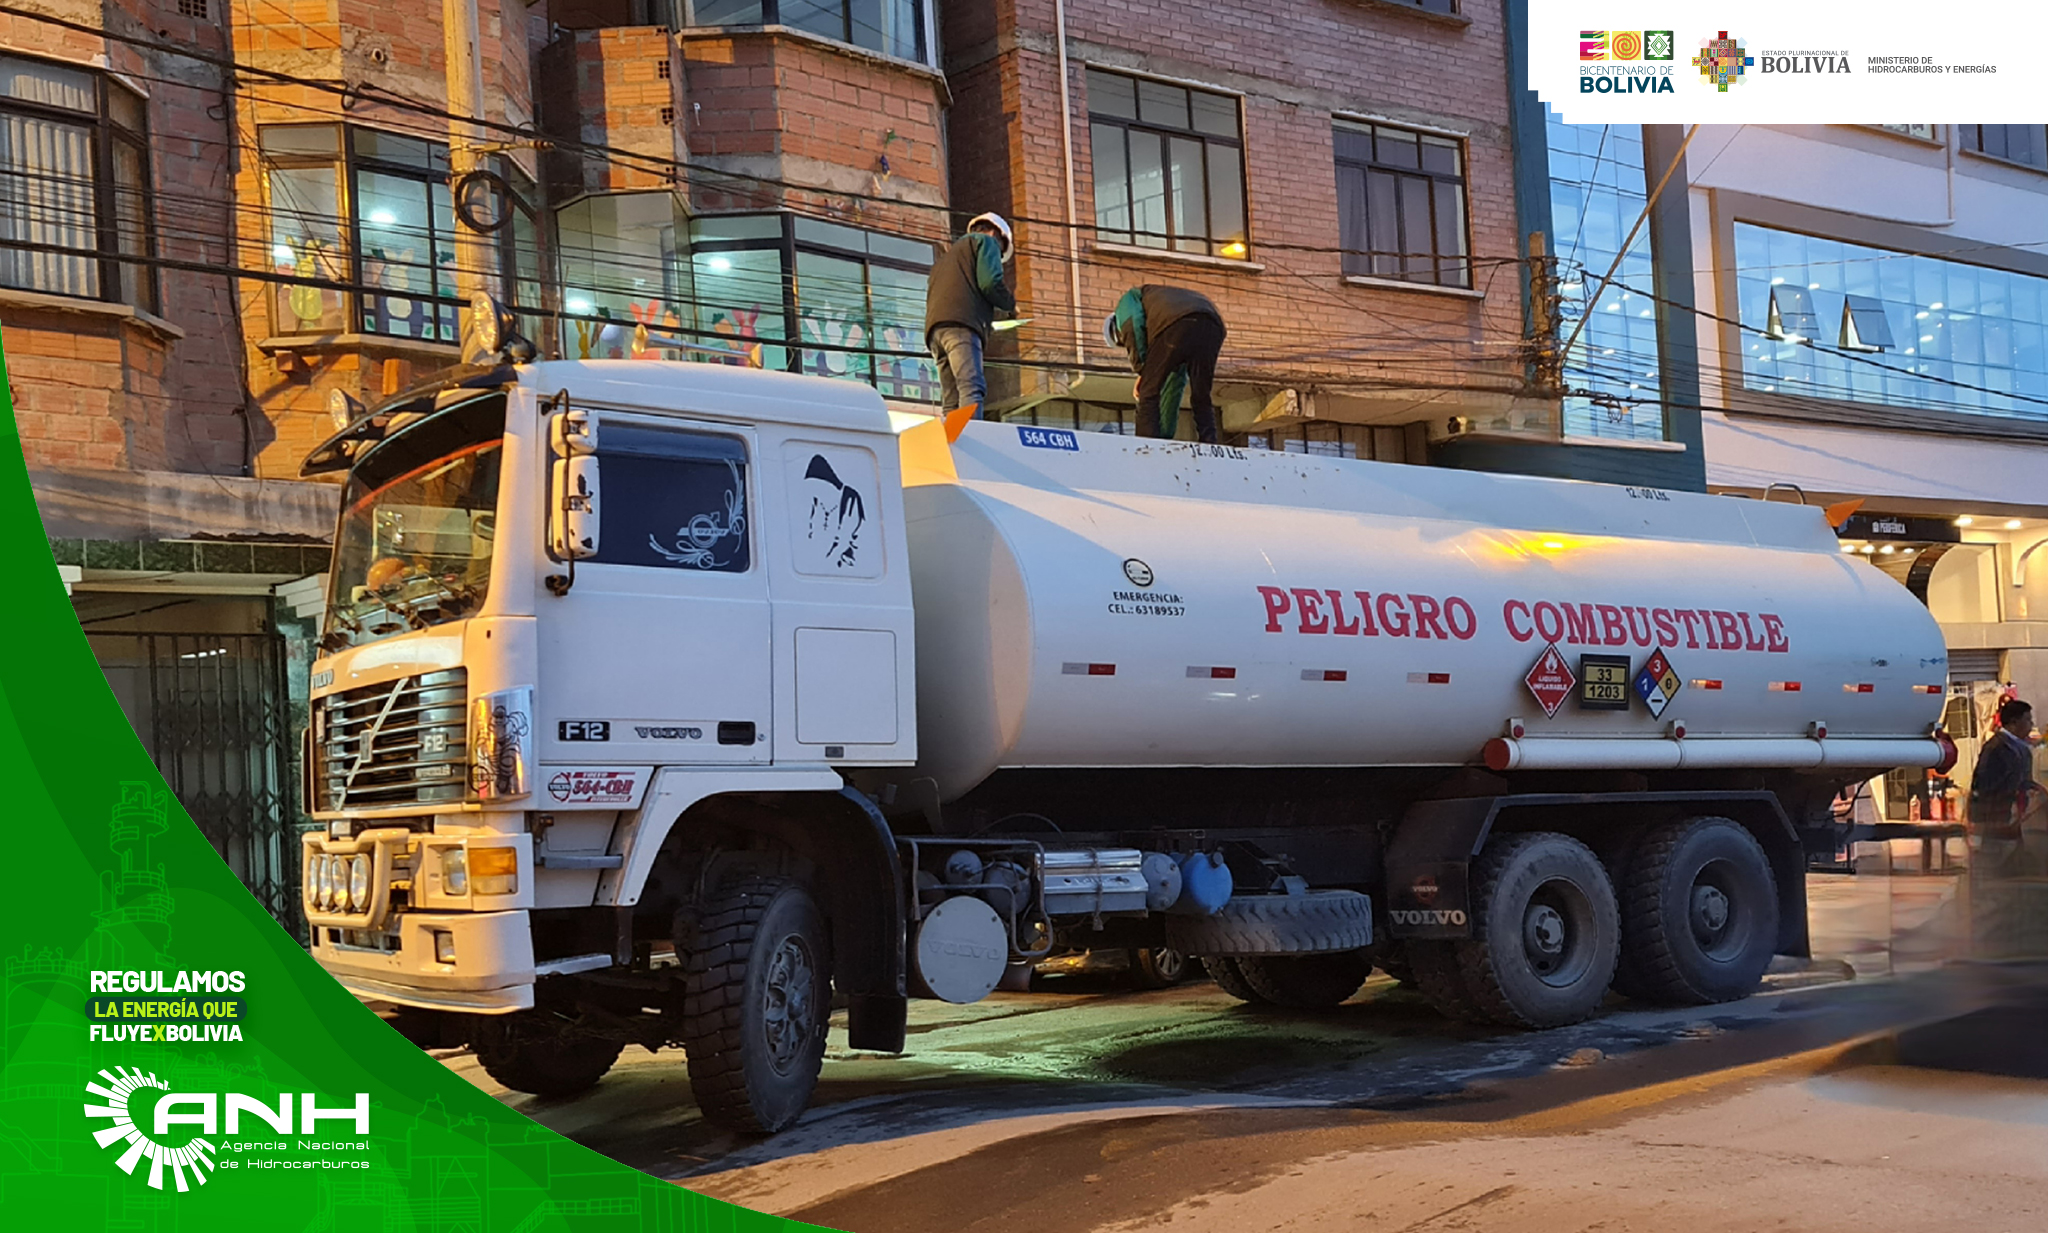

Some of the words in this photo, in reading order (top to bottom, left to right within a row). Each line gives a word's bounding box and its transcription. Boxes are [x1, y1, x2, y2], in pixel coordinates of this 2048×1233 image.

[1024, 431, 1047, 446] 564
[1049, 434, 1074, 449] CBH
[1113, 591, 1184, 604] EMERGENCIA:
[1135, 605, 1185, 617] 63189537
[1257, 586, 1477, 641] PELIGRO
[1503, 599, 1790, 653] COMBUSTIBLE
[1653, 660, 1662, 673] 3
[1596, 668, 1613, 682] 33
[1641, 677, 1649, 692] 1
[1665, 677, 1672, 690] 0
[1589, 685, 1620, 699] 1203
[1548, 702, 1554, 712] 3
[565, 722, 604, 740] F12
[634, 727, 703, 740] VOLVO
[1389, 909, 1467, 925] VOLVO
